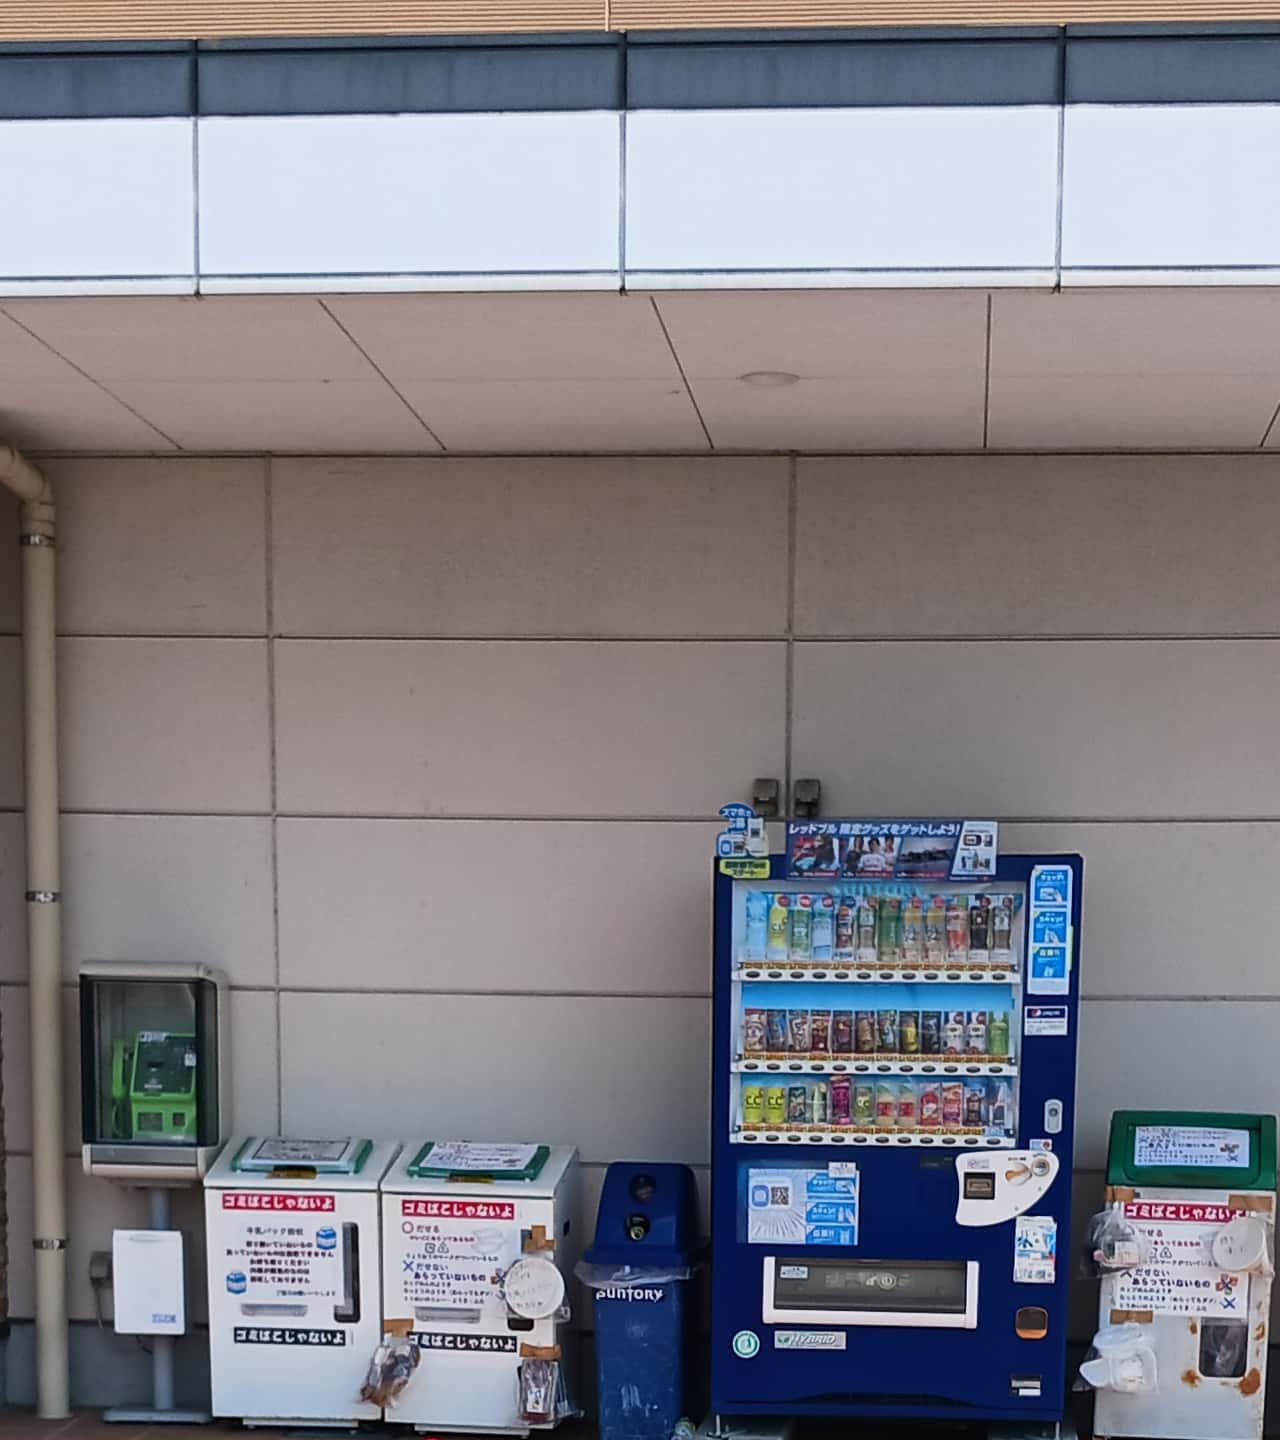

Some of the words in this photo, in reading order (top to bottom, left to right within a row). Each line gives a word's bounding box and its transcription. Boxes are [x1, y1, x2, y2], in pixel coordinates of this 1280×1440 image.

[404, 1202, 513, 1218] ゴミばこじゃないよ
[1132, 1278, 1211, 1288] あらっていないもの
[235, 1329, 345, 1344] ゴミばこじゃないよ
[409, 1333, 516, 1350] ゴミばこじゃないよ
